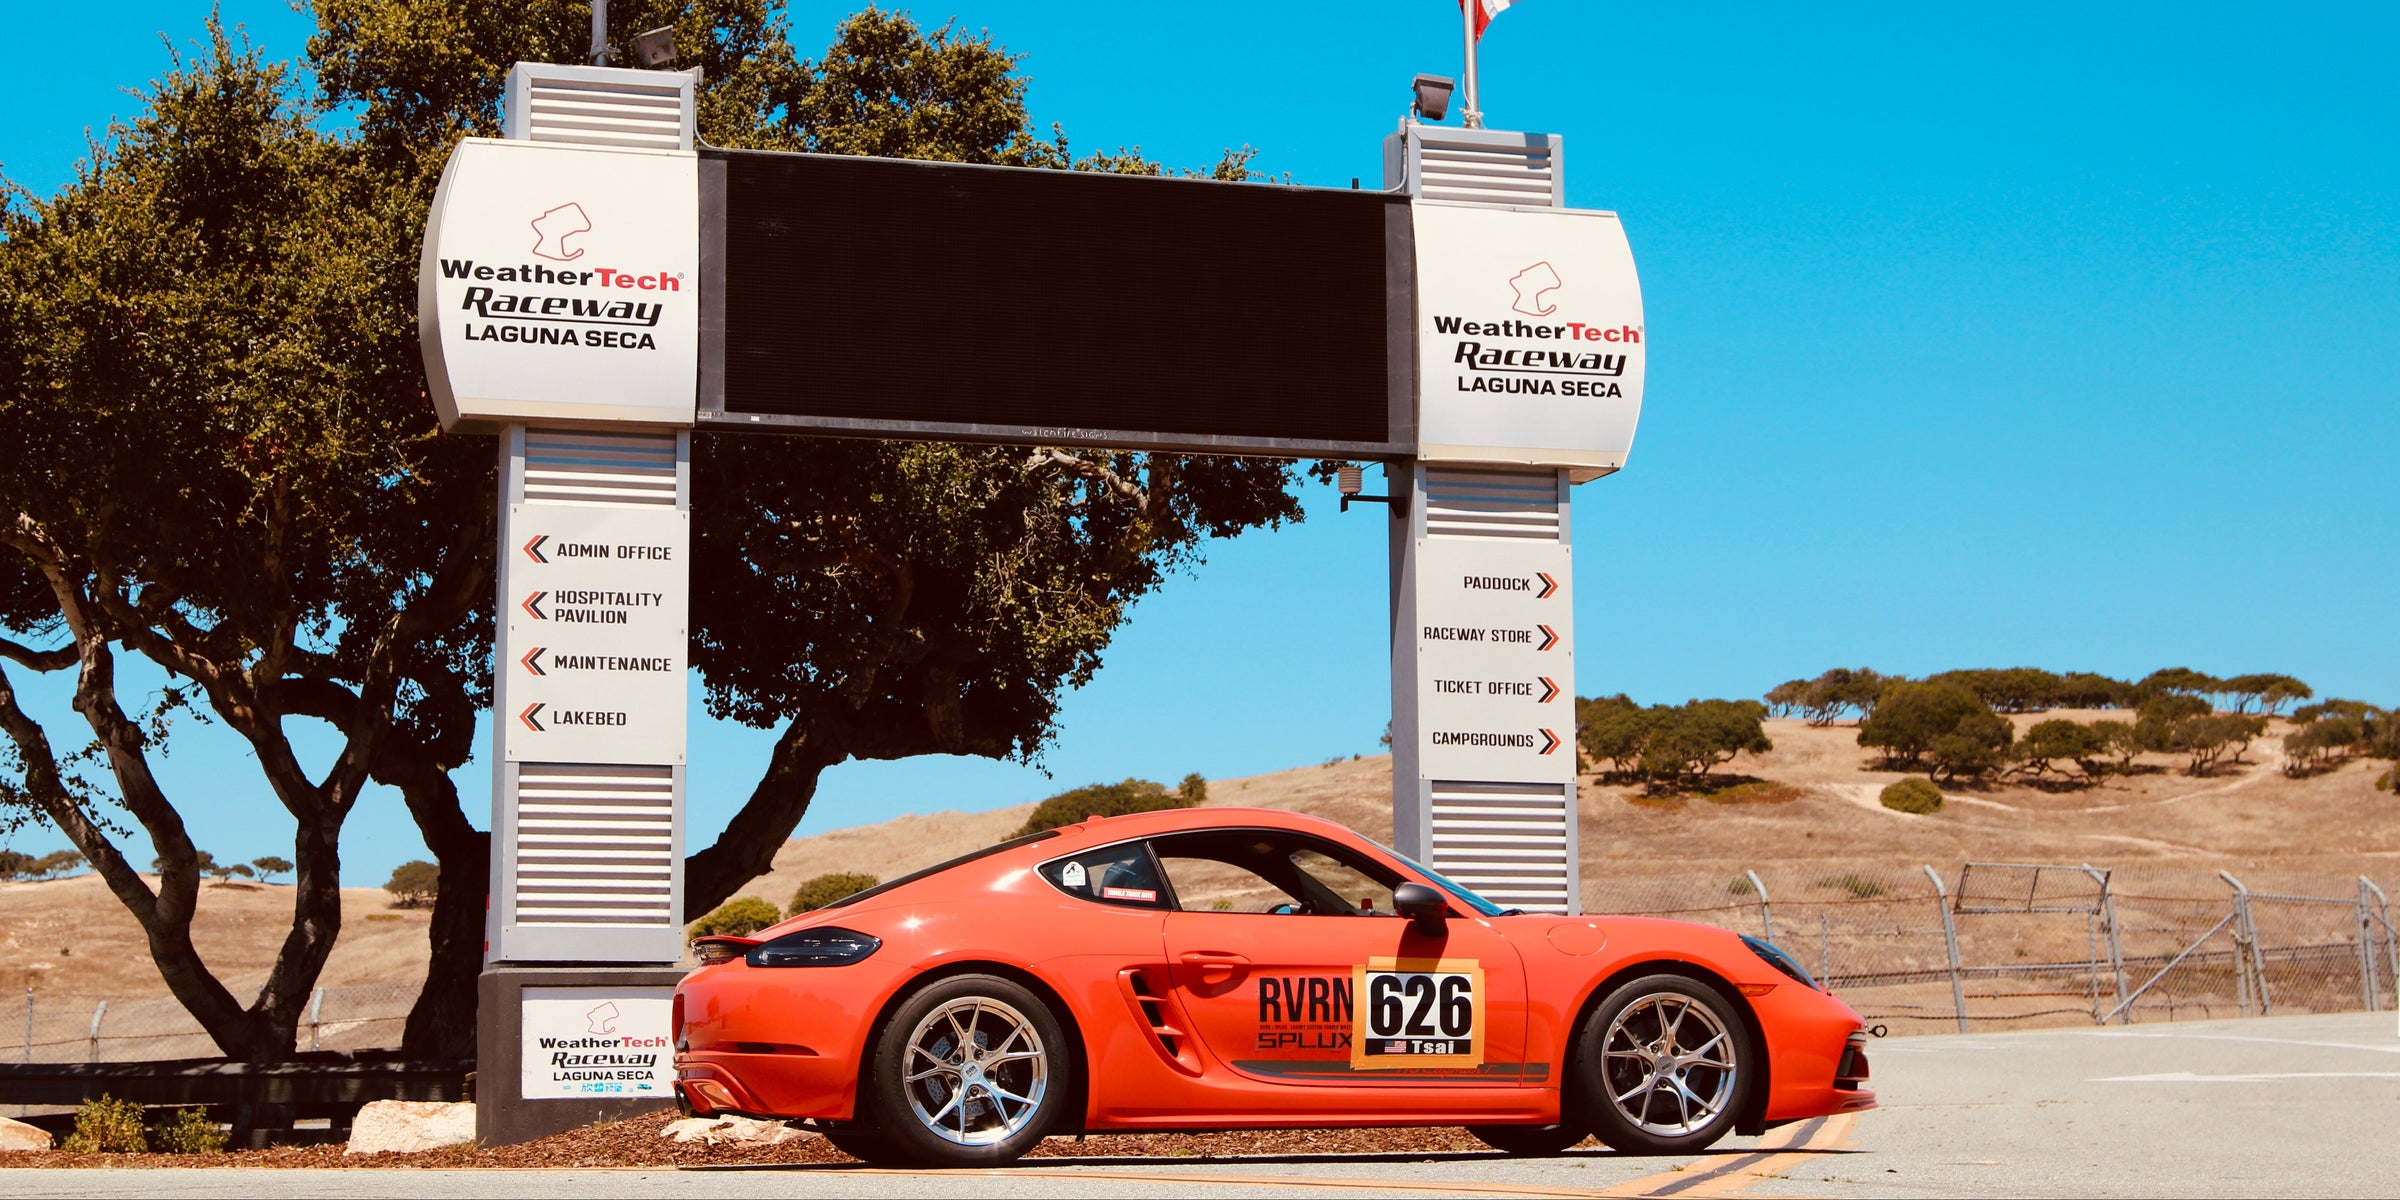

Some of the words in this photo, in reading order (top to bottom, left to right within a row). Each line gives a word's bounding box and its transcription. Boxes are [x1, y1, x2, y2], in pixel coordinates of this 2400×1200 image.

[462, 286, 663, 327] Raceway
[465, 323, 579, 346] LAGUNA
[585, 330, 656, 350] SECA
[1454, 341, 1627, 376] Raceway
[1458, 376, 1556, 395] LAGUNA
[1561, 380, 1622, 398] SECA
[557, 543, 610, 558] ADMIN
[617, 545, 672, 560] OFFICE
[1464, 576, 1531, 591] PADDOCK
[555, 590, 663, 607] HOSPITALITY
[555, 608, 627, 624] PAVILION
[1424, 626, 1486, 642] RACEWAY
[1491, 629, 1532, 643] STORE
[554, 655, 672, 672] MAINTENANCE
[1434, 680, 1482, 694] TICKET
[1488, 681, 1533, 696] OFFICE
[553, 710, 627, 726] LAKEBED
[1432, 731, 1534, 748] CAMPGROUNDS
[1259, 977, 1353, 1022] RVRN
[1370, 975, 1472, 1037] 626
[1258, 1032, 1352, 1049] SPLUX
[1412, 1040, 1454, 1054] Tsai
[551, 1051, 657, 1068] Raceway
[553, 1071, 613, 1081] LAGUNA
[617, 1070, 654, 1080] SECA
